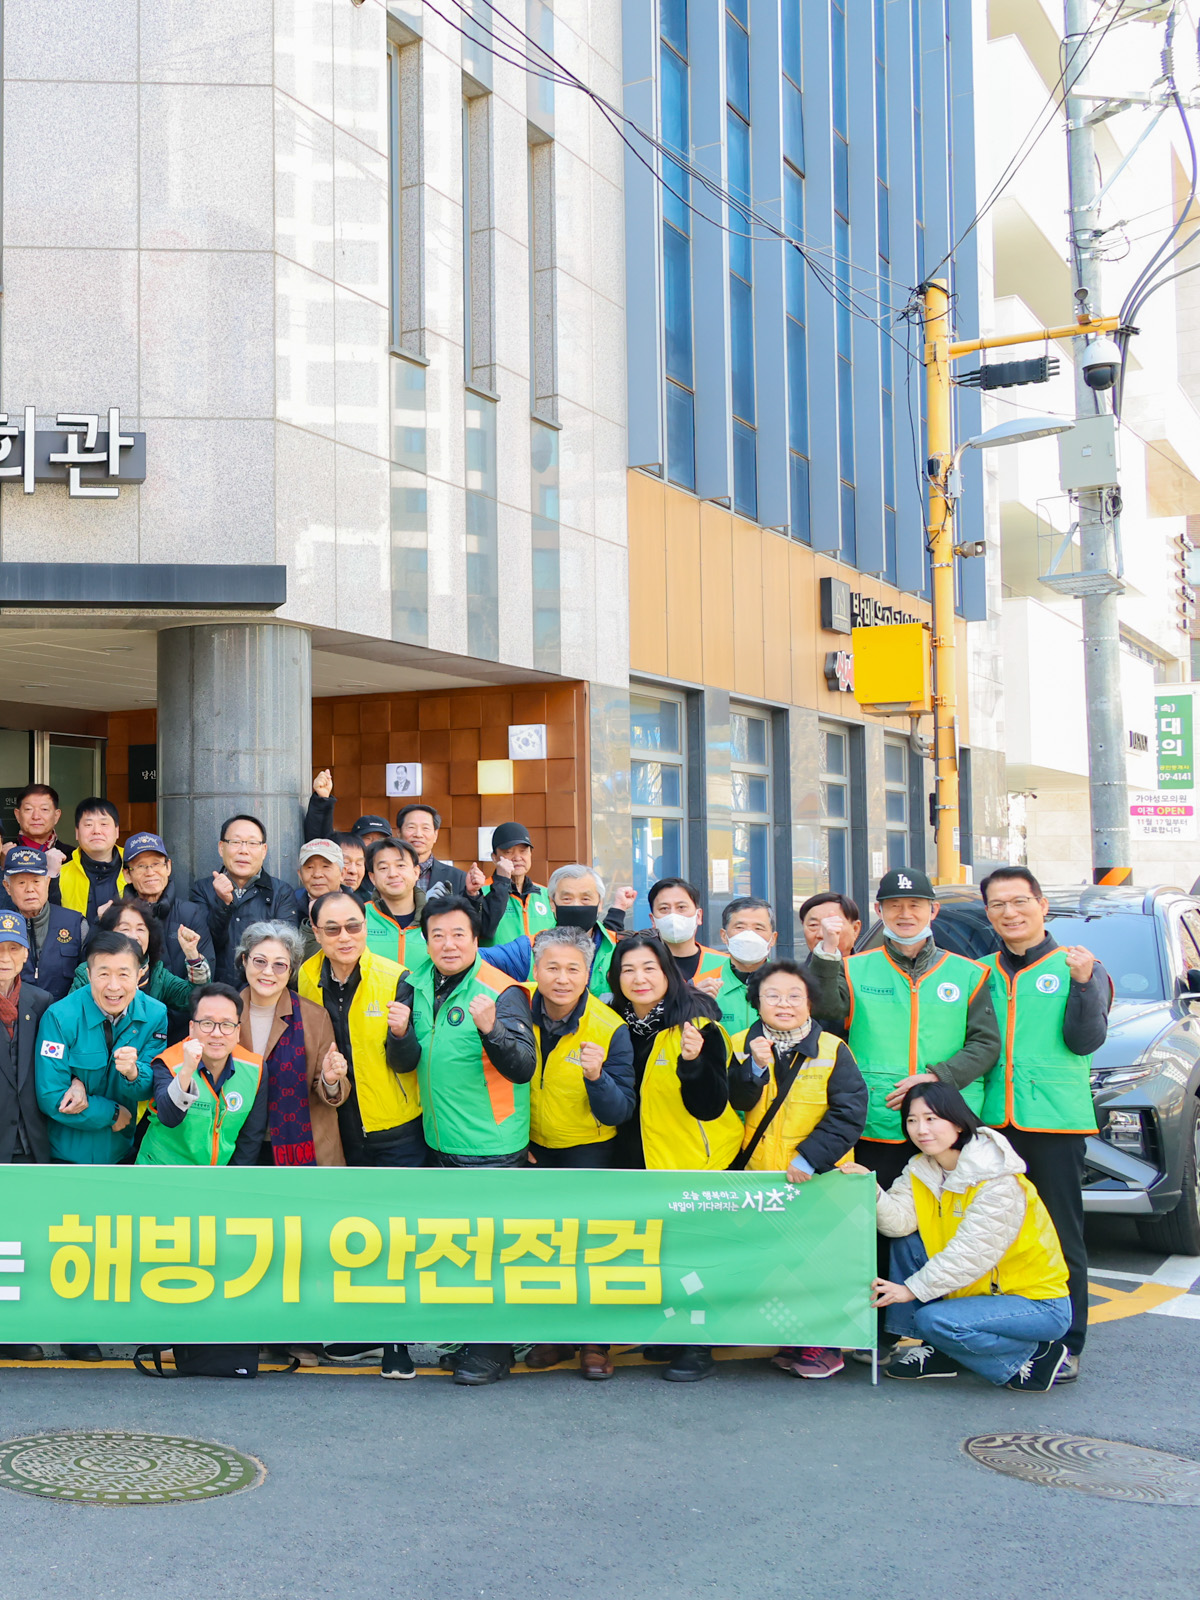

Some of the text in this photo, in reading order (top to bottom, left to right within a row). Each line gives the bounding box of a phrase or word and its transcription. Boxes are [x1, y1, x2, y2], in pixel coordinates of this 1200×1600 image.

[1135, 794, 1188, 803] 가야성모의원
[1137, 806, 1186, 815] 이전 OPEN
[1142, 826, 1181, 834] 진료합니다
[897, 873, 913, 889] LA
[682, 1190, 740, 1201] 오늘 행복하고
[741, 1188, 786, 1213] 서초
[668, 1201, 741, 1213] 내일이 기다려지는
[49, 1214, 302, 1304] 해빙기
[329, 1217, 664, 1306] 안전점검
